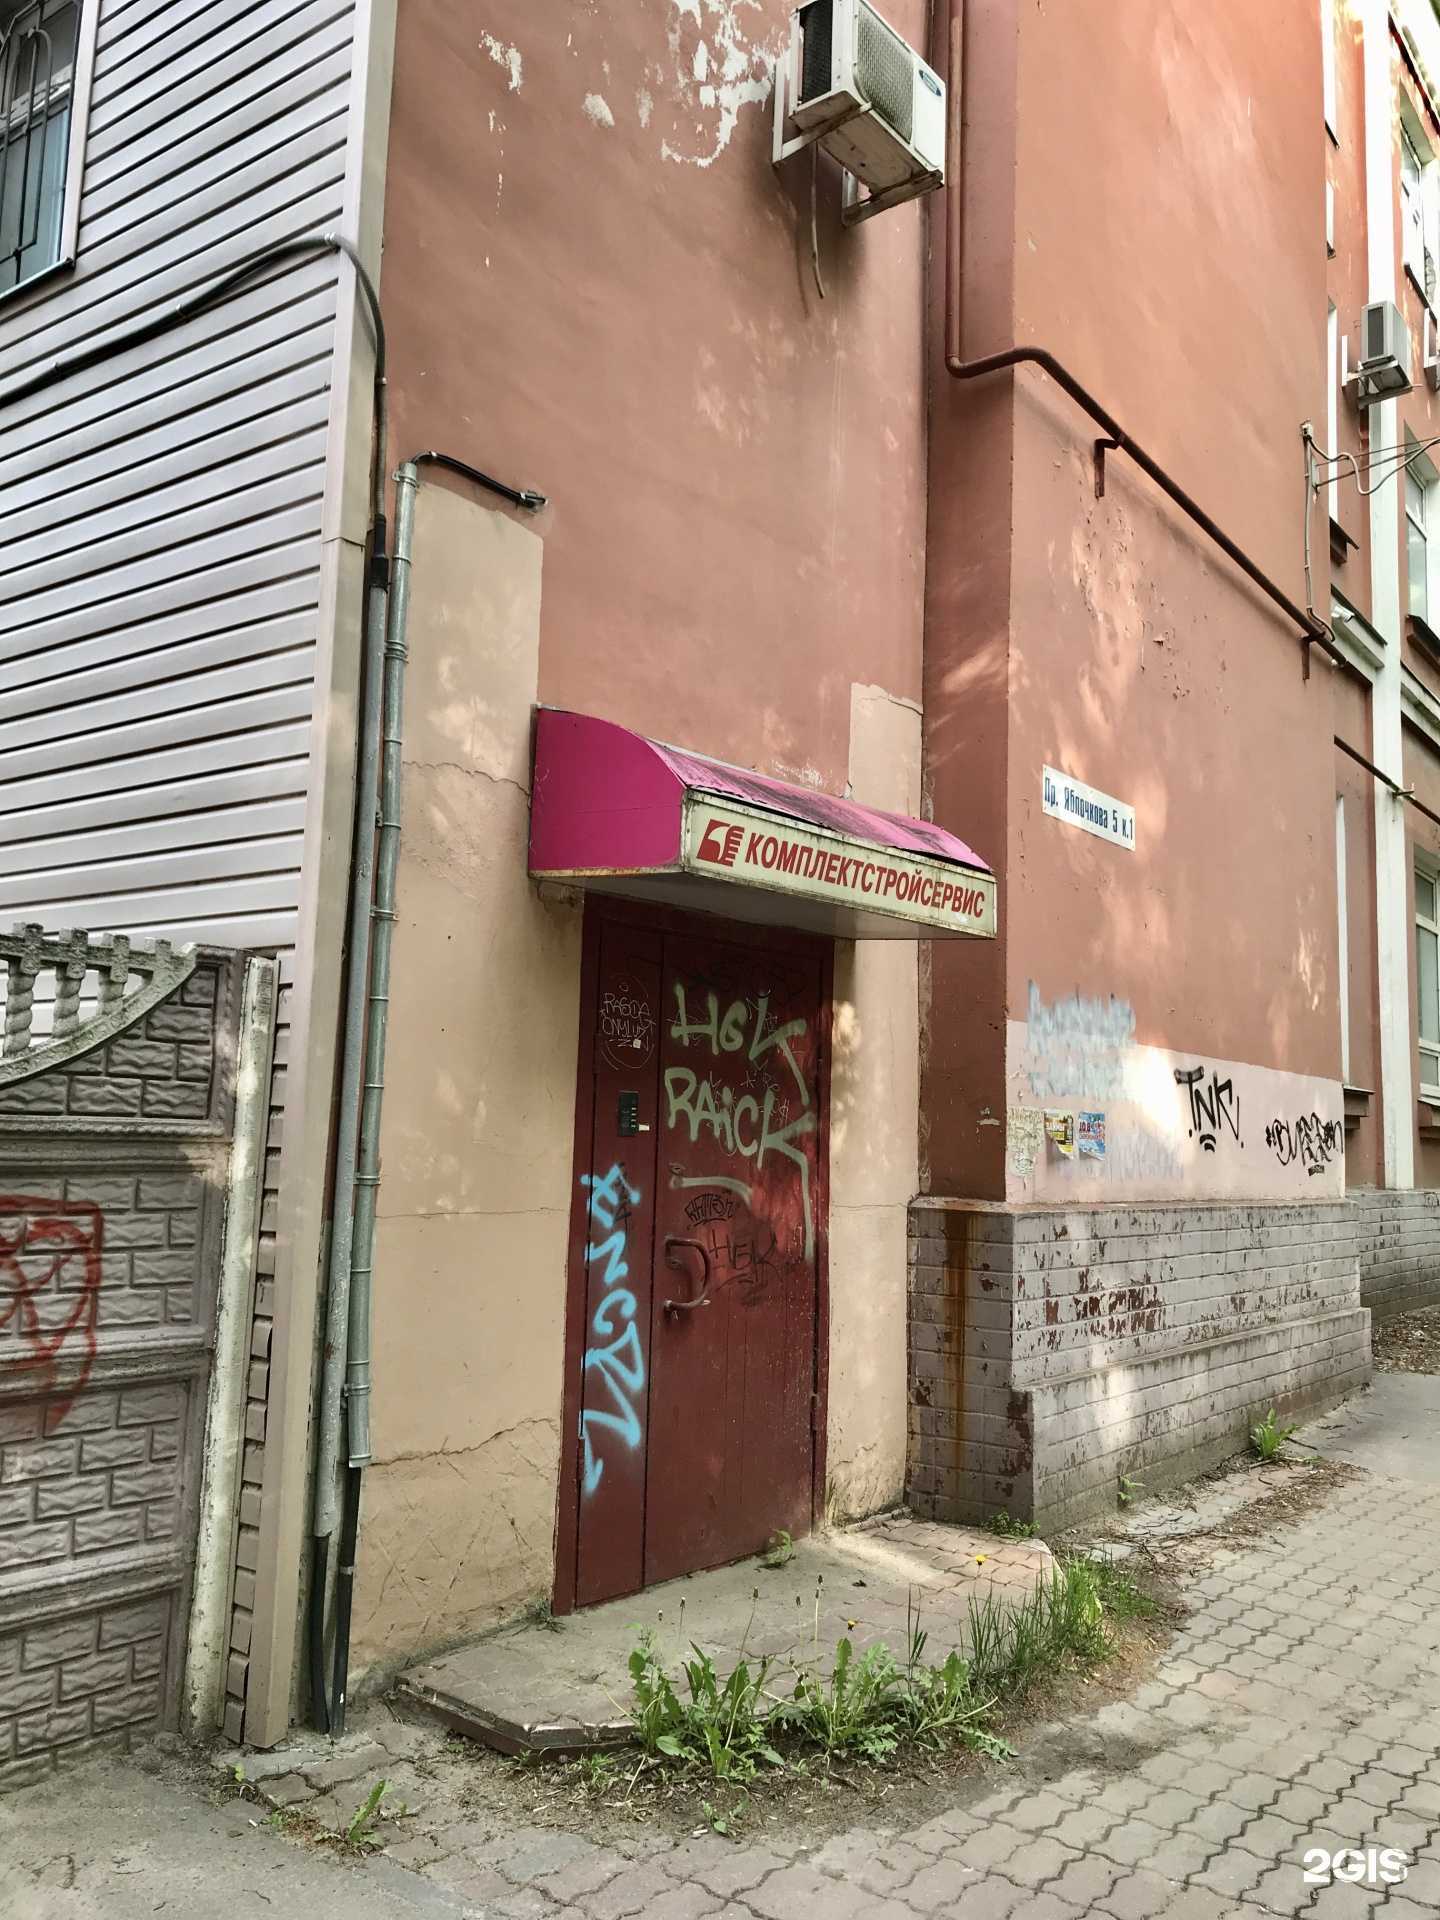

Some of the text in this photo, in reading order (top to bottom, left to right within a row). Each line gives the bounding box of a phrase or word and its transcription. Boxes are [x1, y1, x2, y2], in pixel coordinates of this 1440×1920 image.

[1044, 776, 1059, 808] Пр.
[1063, 786, 1108, 829] Яблочкова
[1112, 809, 1118, 833] 5
[745, 833, 986, 919] КОМПЛЕКТСТРОЙСЕРВИС
